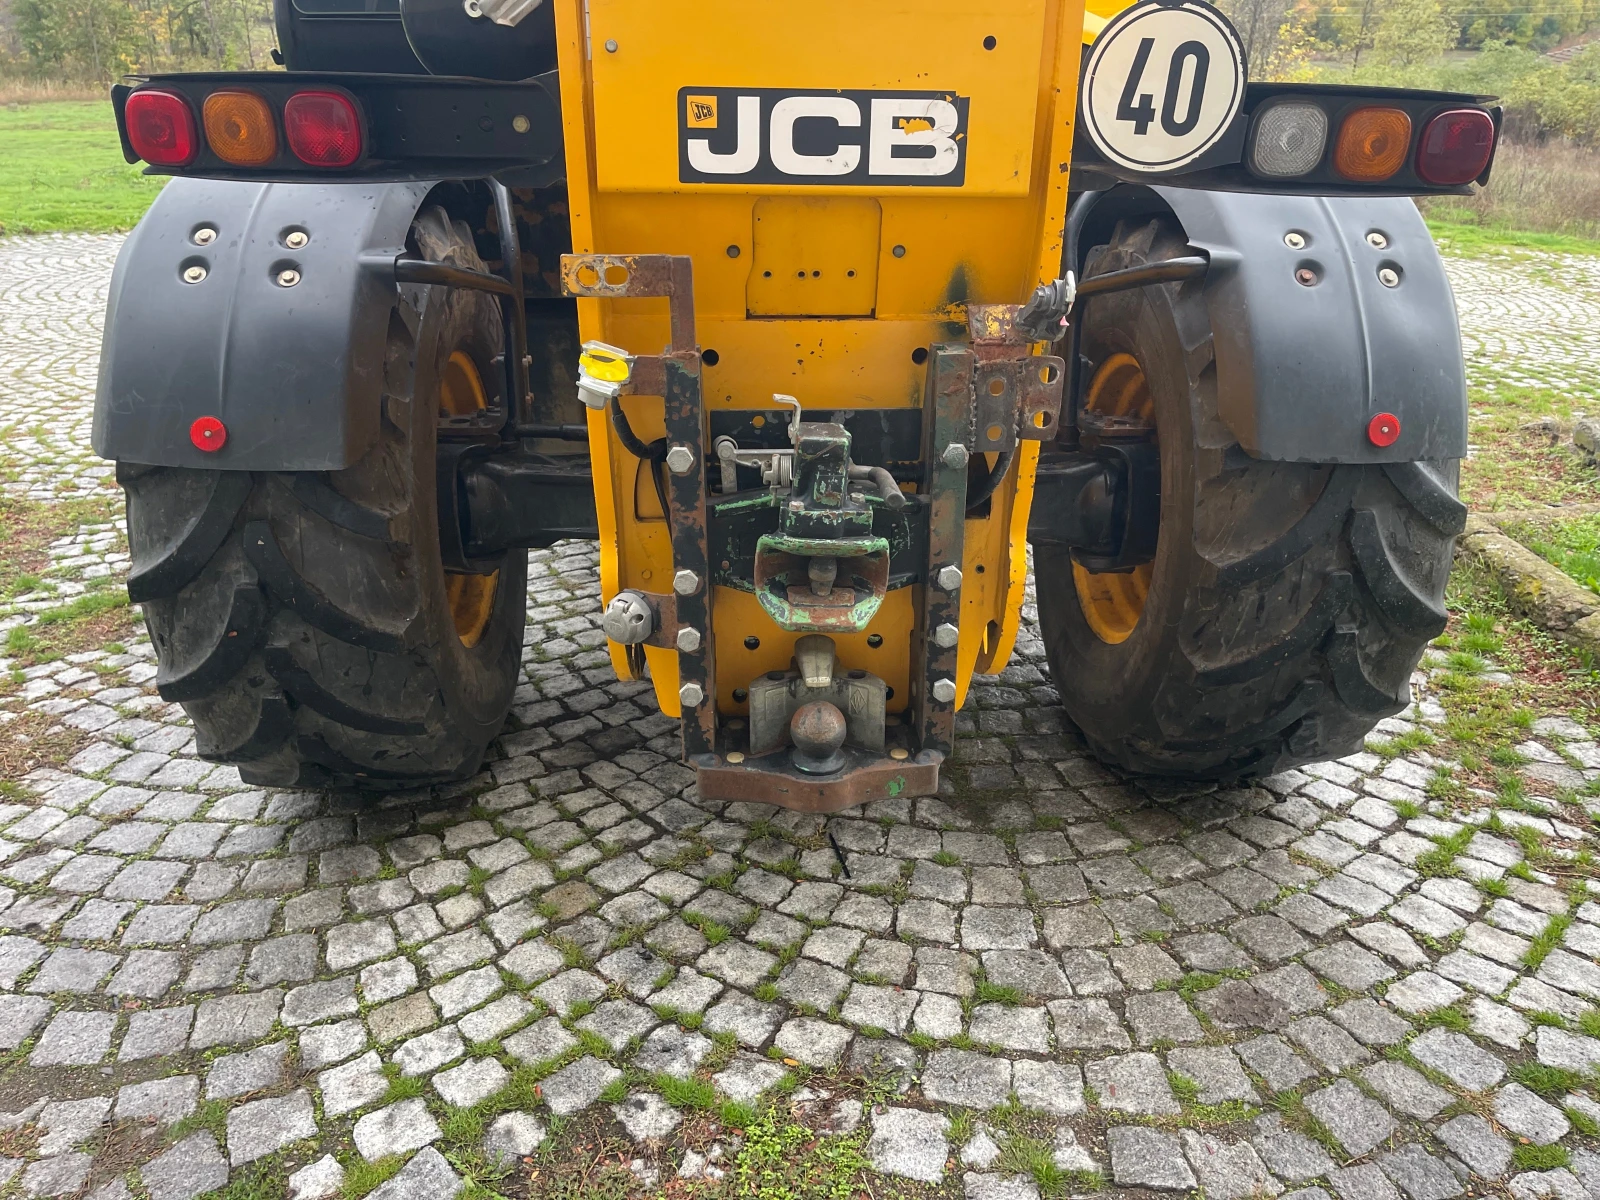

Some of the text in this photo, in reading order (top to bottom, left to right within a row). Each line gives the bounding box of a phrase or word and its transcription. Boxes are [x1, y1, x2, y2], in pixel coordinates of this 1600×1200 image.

[694, 103, 713, 120] JCB
[1115, 37, 1210, 137] 40
[687, 96, 959, 176] JCB
